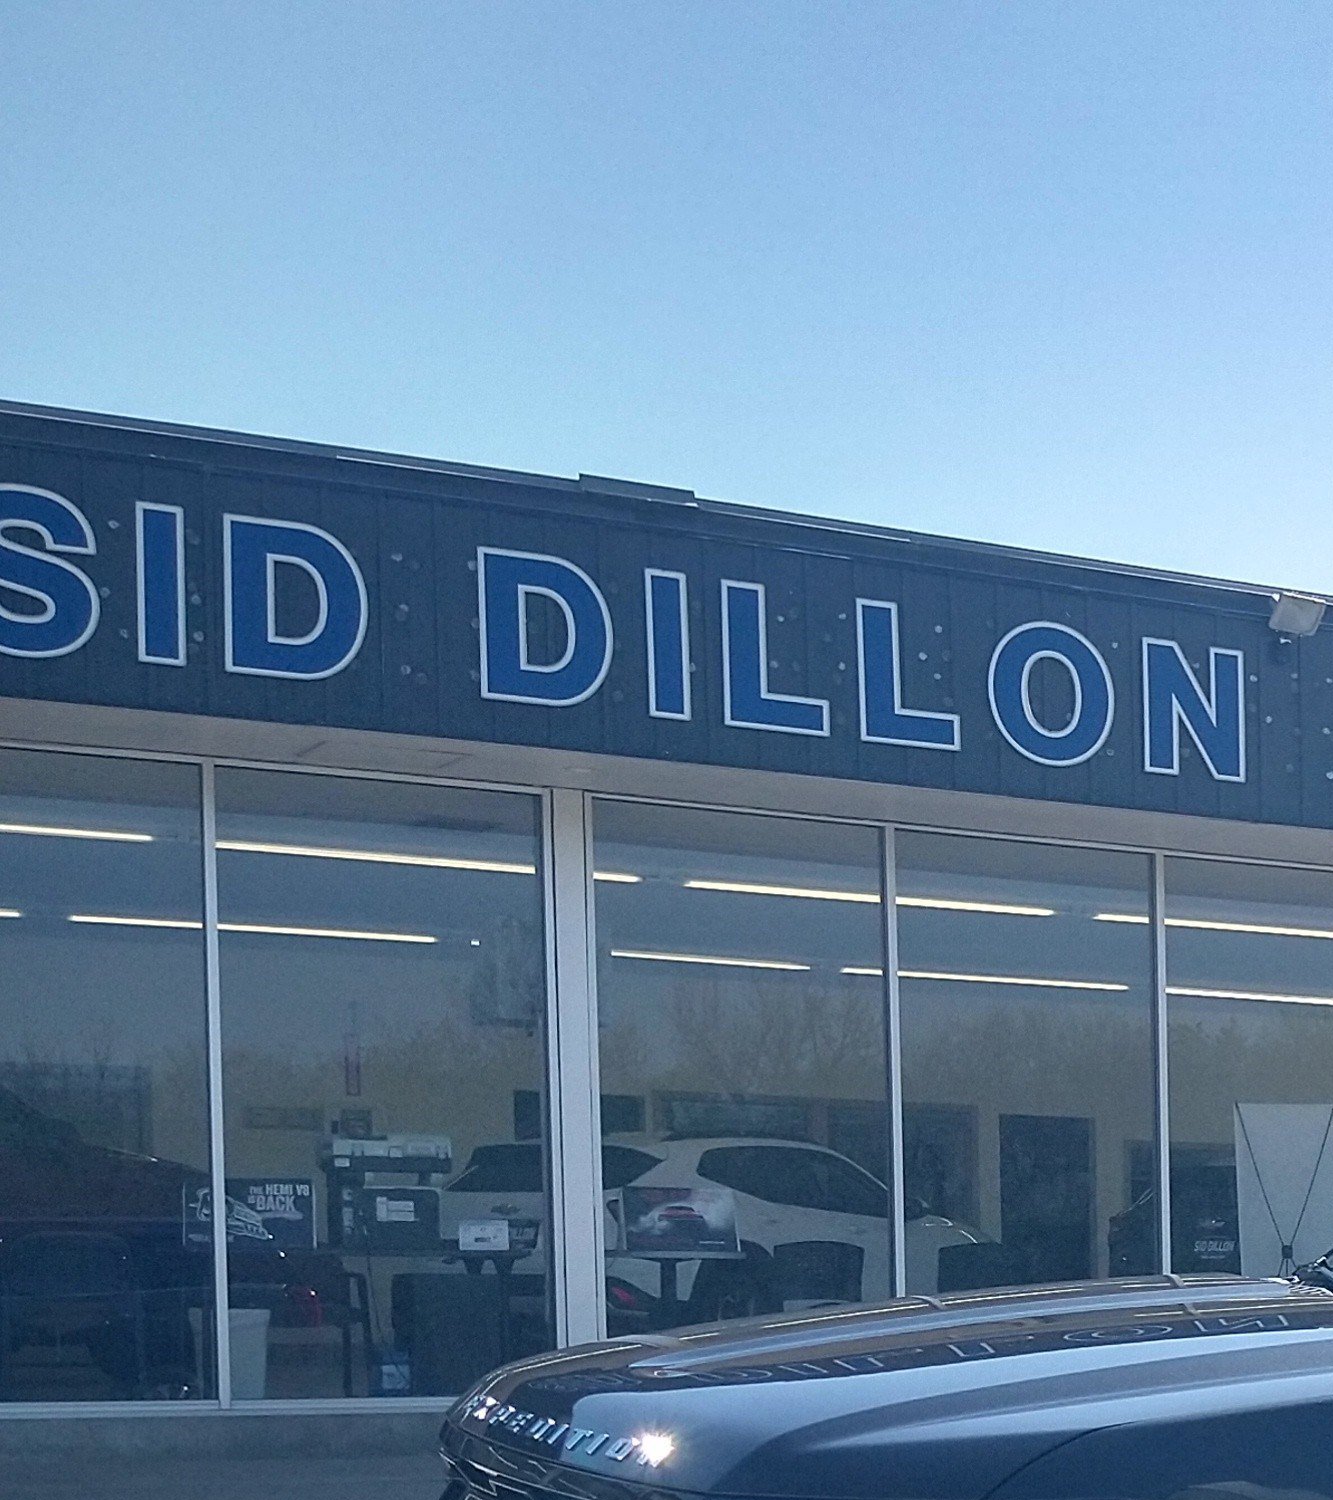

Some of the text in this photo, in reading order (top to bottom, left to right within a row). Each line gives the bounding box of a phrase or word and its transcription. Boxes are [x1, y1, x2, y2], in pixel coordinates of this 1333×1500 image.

[0, 483, 1247, 783] SID DILLON
[265, 1183, 293, 1196] HEMI
[256, 1195, 296, 1212] BACK
